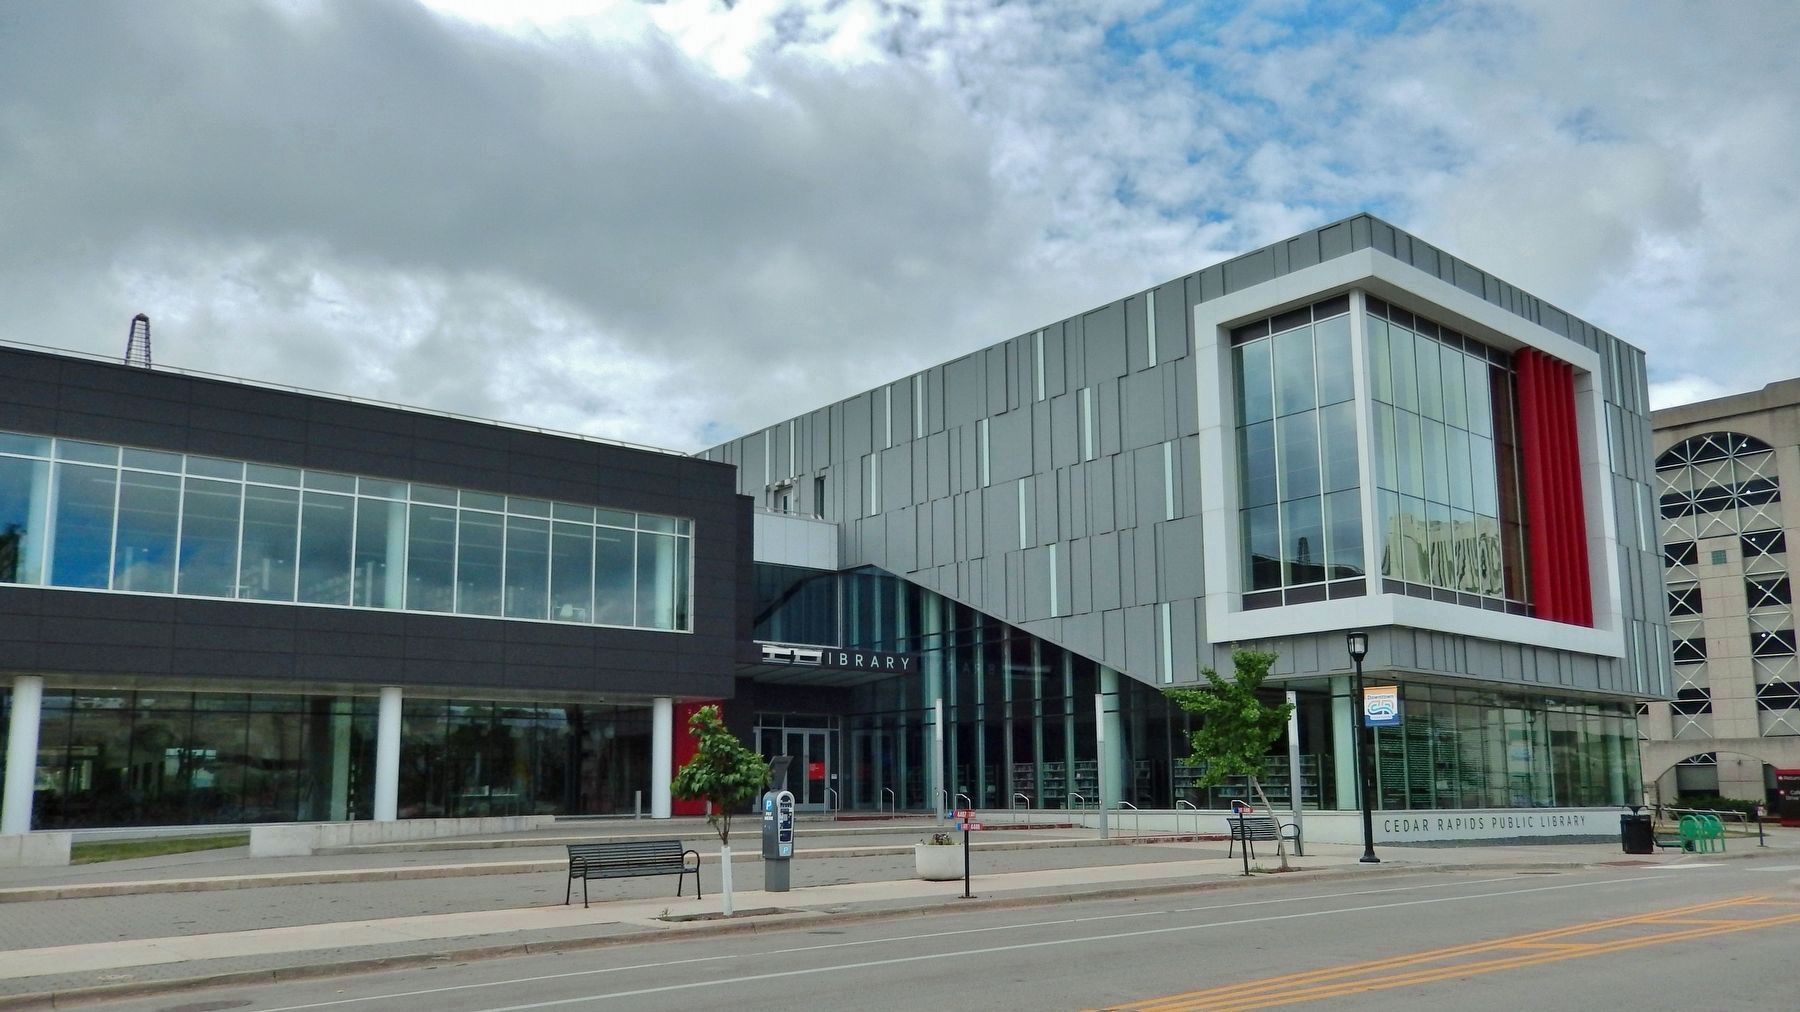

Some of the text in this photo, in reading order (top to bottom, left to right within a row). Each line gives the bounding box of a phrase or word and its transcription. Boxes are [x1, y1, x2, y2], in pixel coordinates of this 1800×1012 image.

[824, 651, 910, 670] IBRARY
[766, 800, 772, 810] P
[1384, 815, 1585, 833] CEDAR RAPIDS PUBLIC LIBRARY
